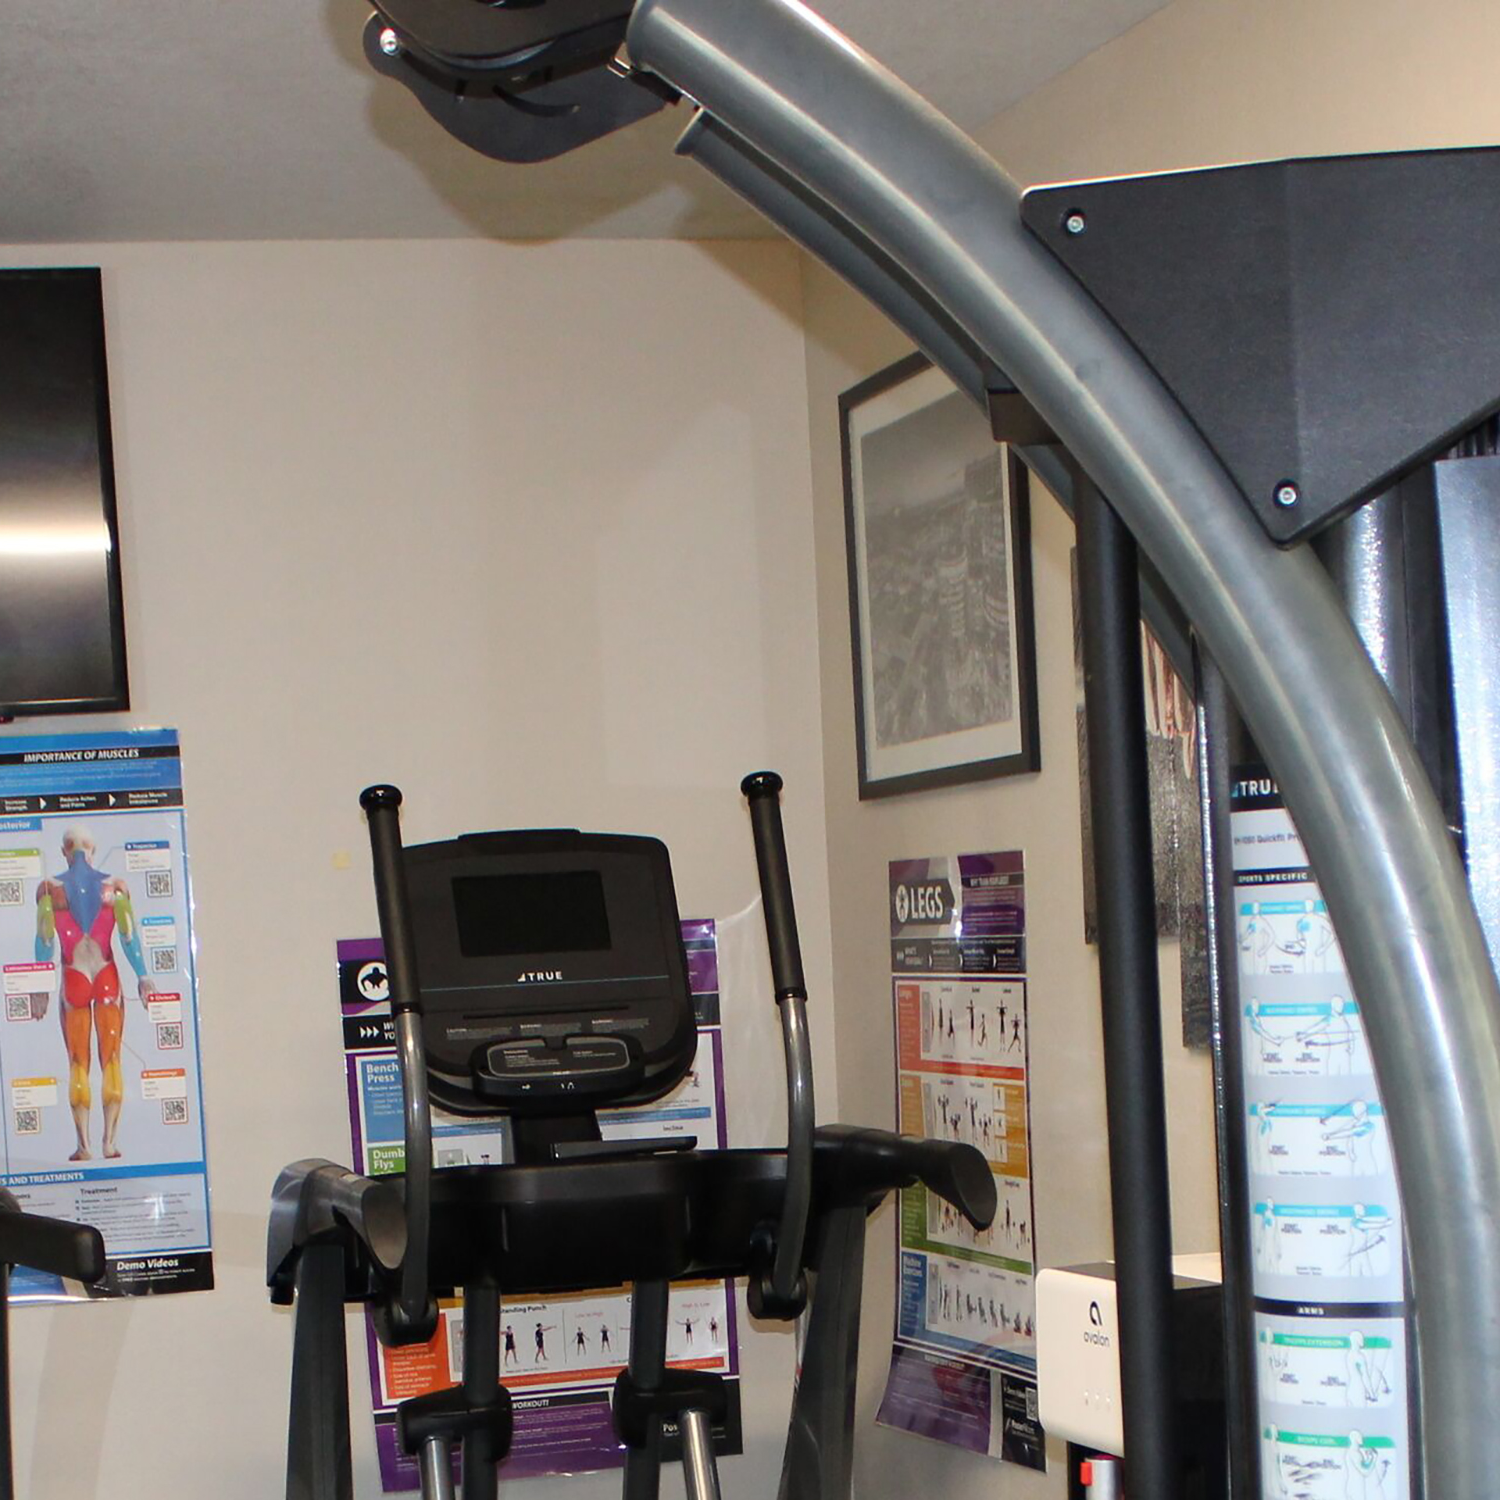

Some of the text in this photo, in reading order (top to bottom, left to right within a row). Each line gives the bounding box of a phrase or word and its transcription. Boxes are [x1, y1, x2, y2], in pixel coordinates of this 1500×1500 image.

[24, 748, 139, 763] IMPORTANCE OF MUSCLES
[1266, 872, 1308, 882] SPECIFIC
[910, 885, 943, 919] LEGS
[527, 970, 563, 981] TRUE
[384, 1031, 396, 1041] YO
[366, 1062, 399, 1073] Bench
[367, 1073, 395, 1083] Press
[373, 1148, 405, 1160] Dumb
[374, 1159, 394, 1170] Flys
[8, 1174, 28, 1185] AND
[29, 1172, 84, 1184] TREATMENTS
[80, 1186, 118, 1195] Treatment
[117, 1258, 179, 1271] Demo Videos
[528, 1304, 547, 1313] Punch
[1297, 1306, 1324, 1315] ARMS
[1084, 1331, 1110, 1348] avalon
